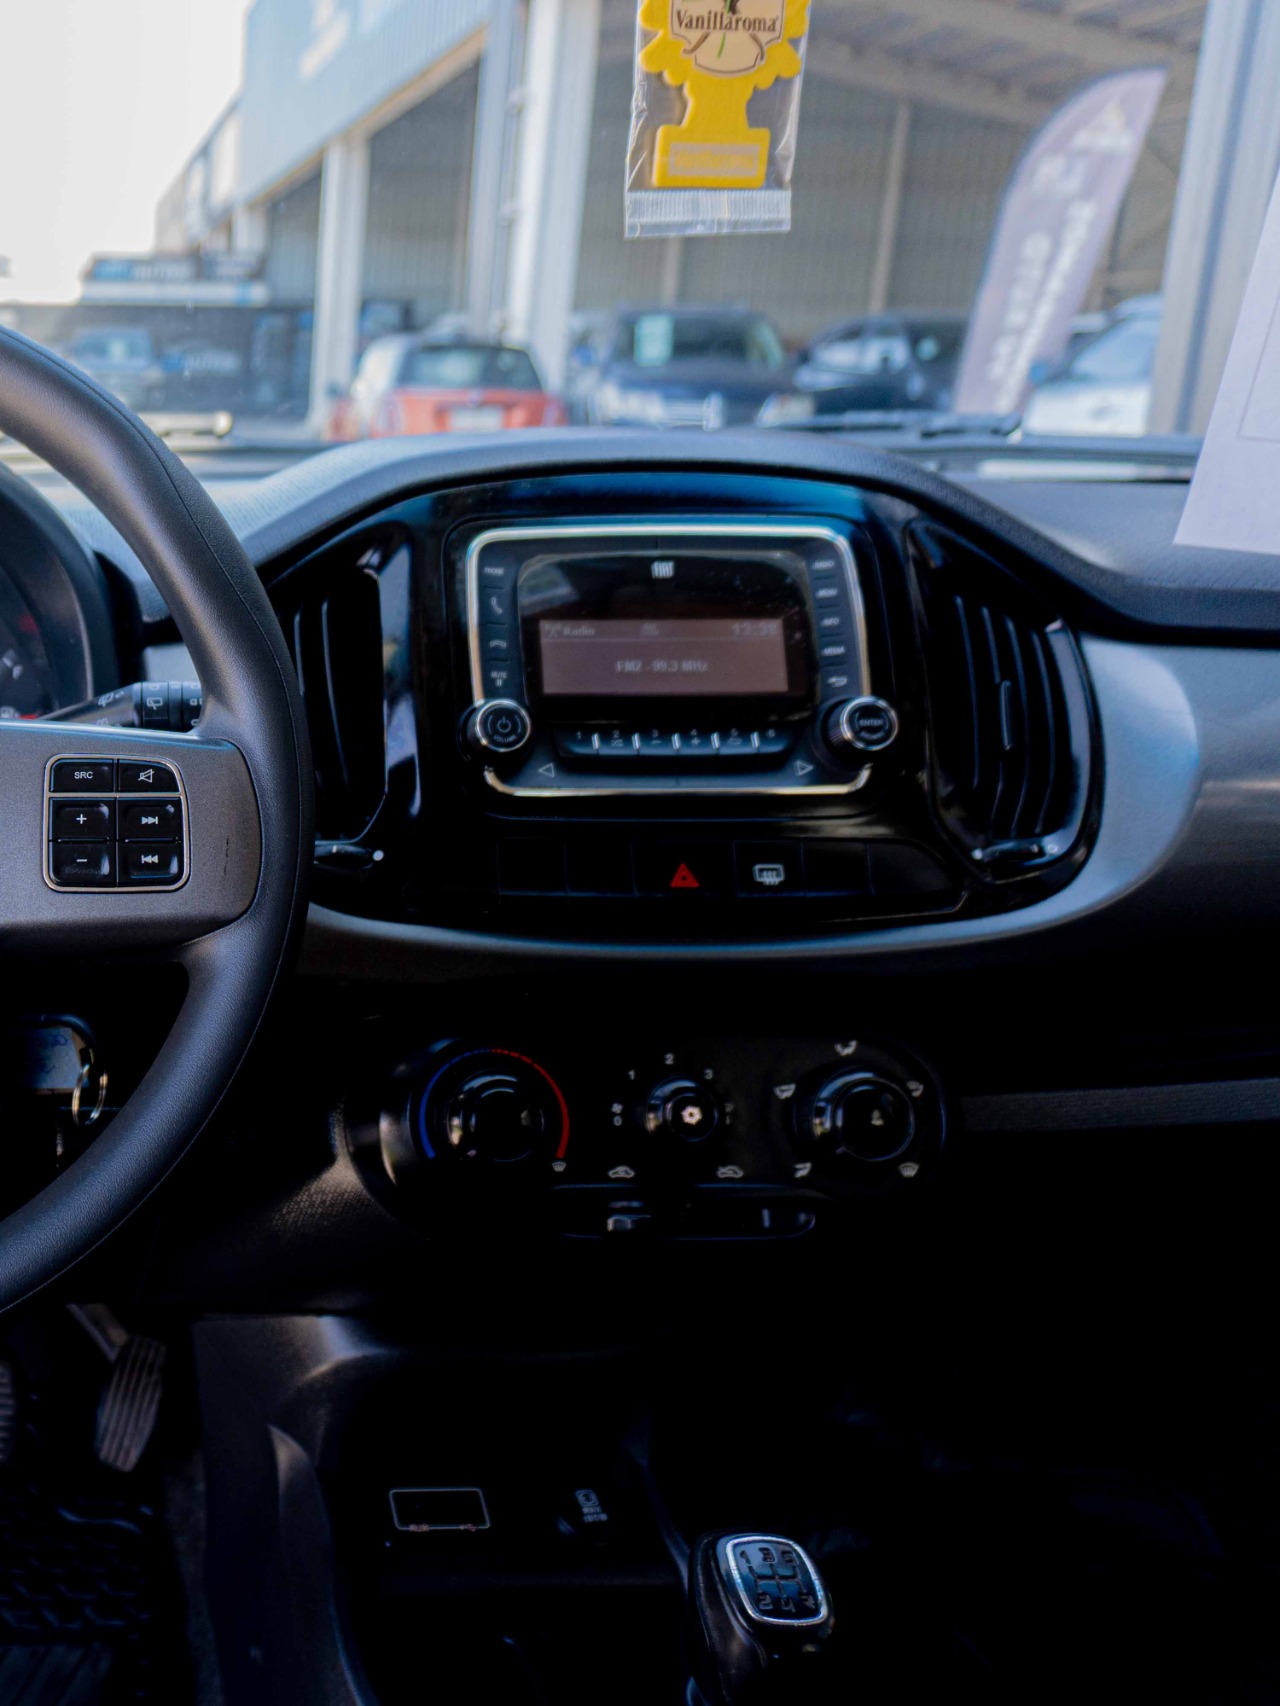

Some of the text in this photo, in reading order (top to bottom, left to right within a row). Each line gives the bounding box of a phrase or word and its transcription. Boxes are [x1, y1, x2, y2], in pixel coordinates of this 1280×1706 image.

[676, 9, 777, 32] Vanillaroma
[651, 561, 675, 578] FIAT
[682, 659, 709, 673] MHz
[74, 771, 93, 779] SRC
[664, 1053, 675, 1065] 2
[628, 1070, 635, 1080] 1
[704, 1068, 714, 1080] 3
[739, 1550, 751, 1565] 1
[758, 1547, 777, 1564] 3
[757, 1592, 773, 1610] 2
